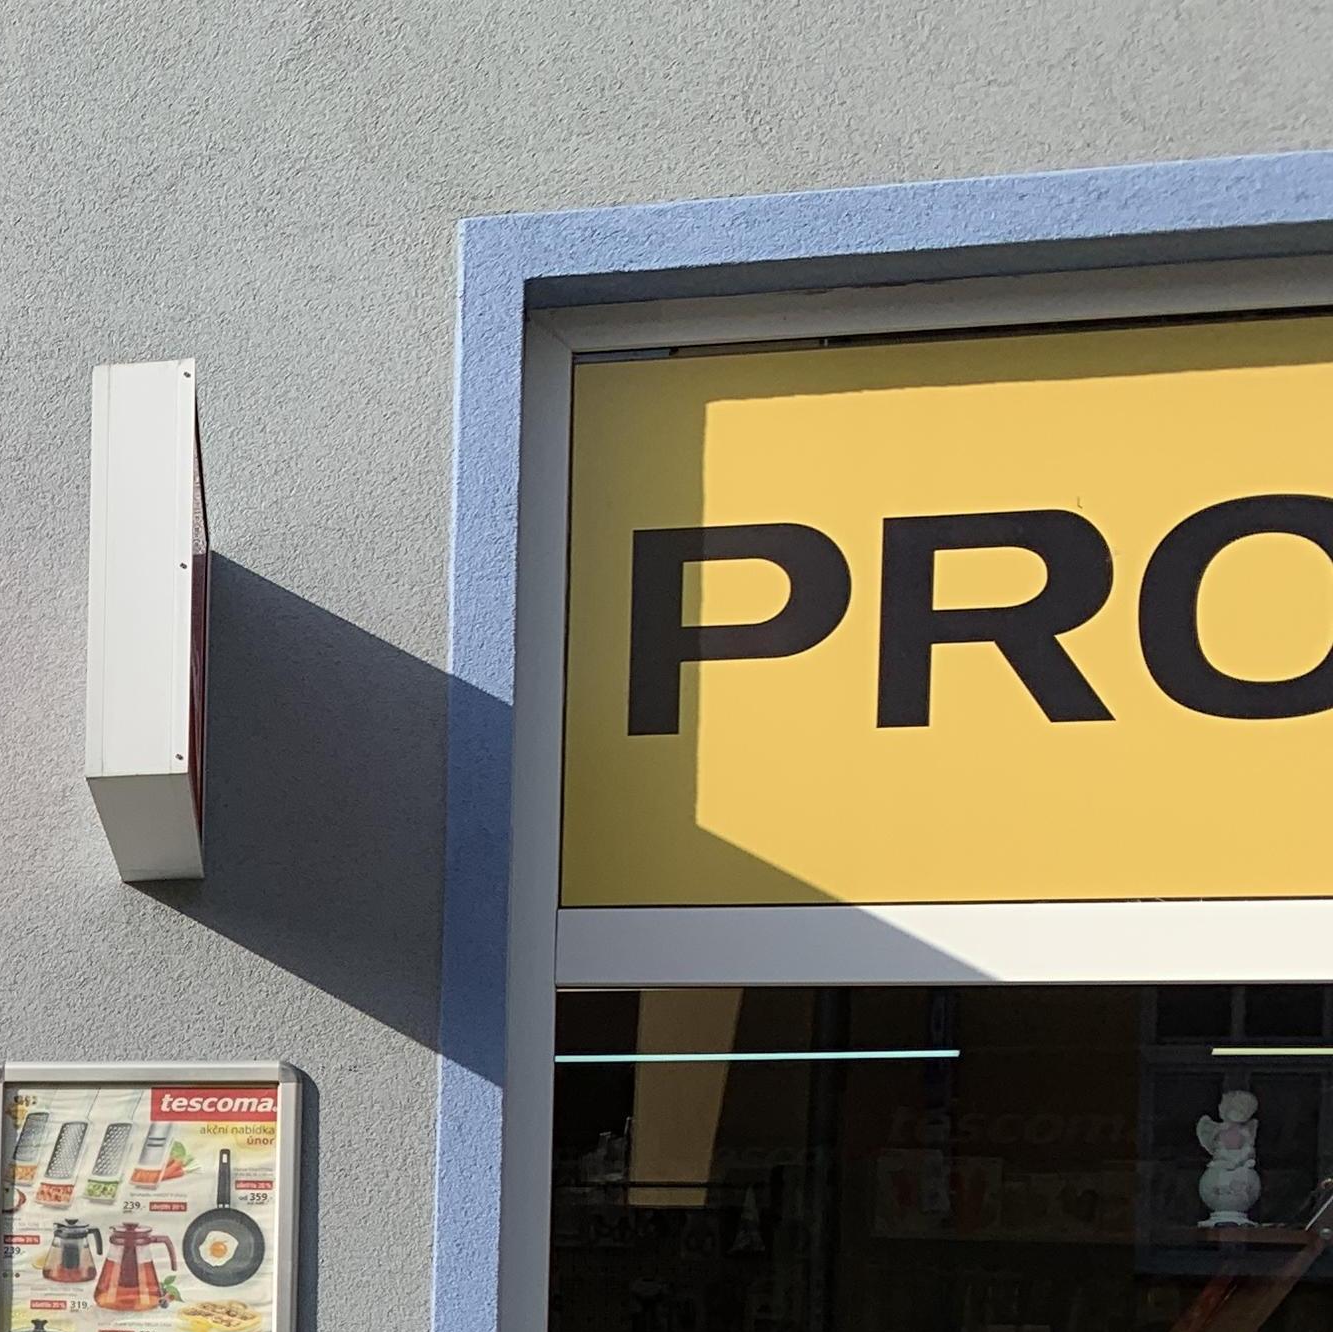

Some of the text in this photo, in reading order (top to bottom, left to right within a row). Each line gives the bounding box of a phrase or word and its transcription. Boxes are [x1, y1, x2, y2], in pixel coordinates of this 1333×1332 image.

[200, 1125, 275, 1135] akční nabídka
[247, 1136, 275, 1145] únor
